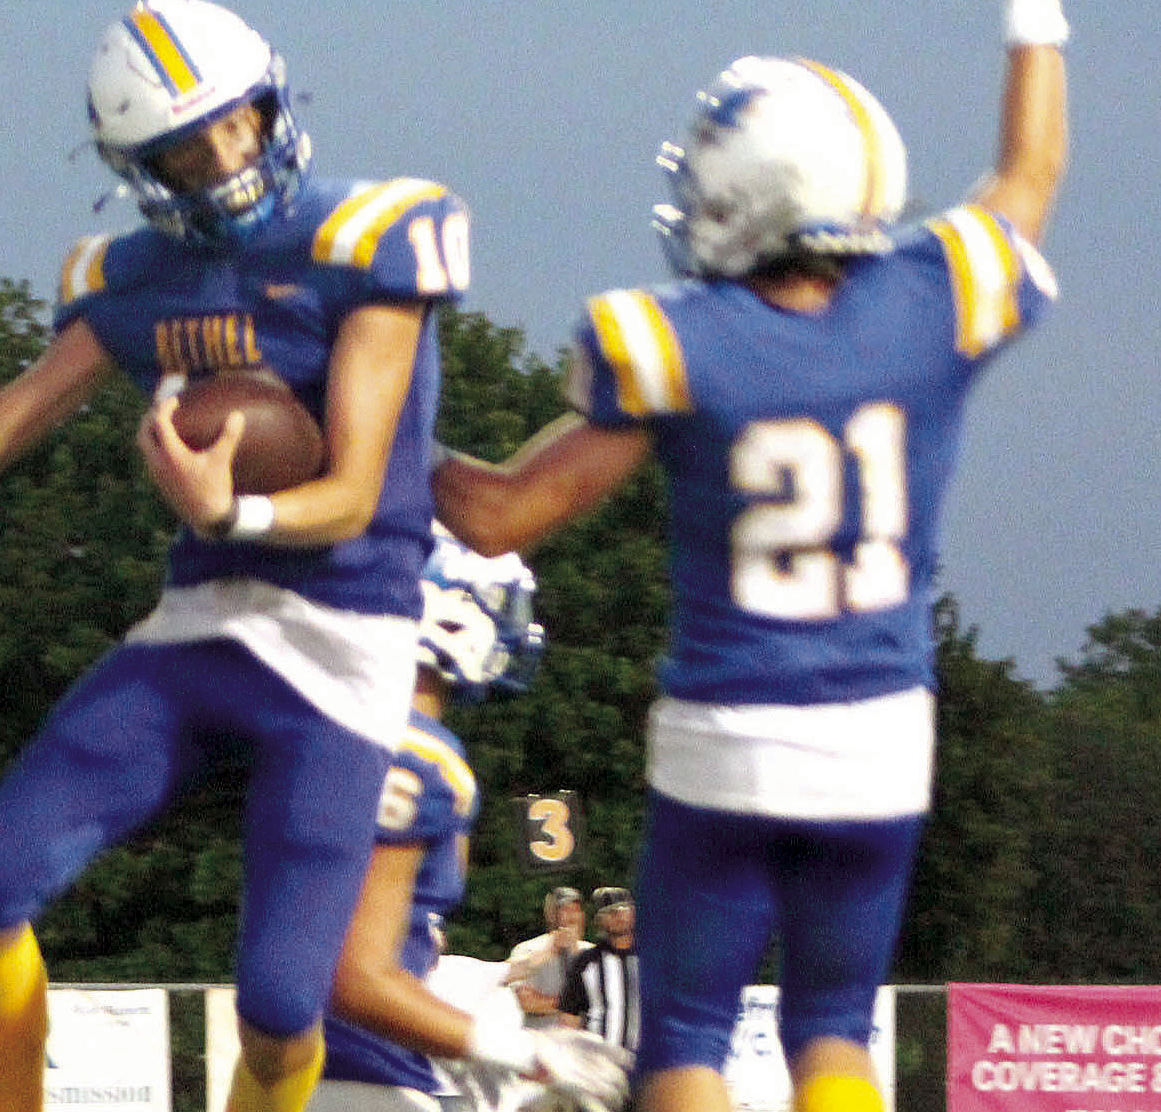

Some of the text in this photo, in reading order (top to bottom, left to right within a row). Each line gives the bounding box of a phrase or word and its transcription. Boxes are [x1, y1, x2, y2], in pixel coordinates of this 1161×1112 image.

[728, 402, 908, 620] 21
[527, 798, 575, 861] 3
[988, 1024, 1016, 1055] A
[1018, 1024, 1098, 1055] NEW
[971, 1061, 1147, 1093] COVERAGE
